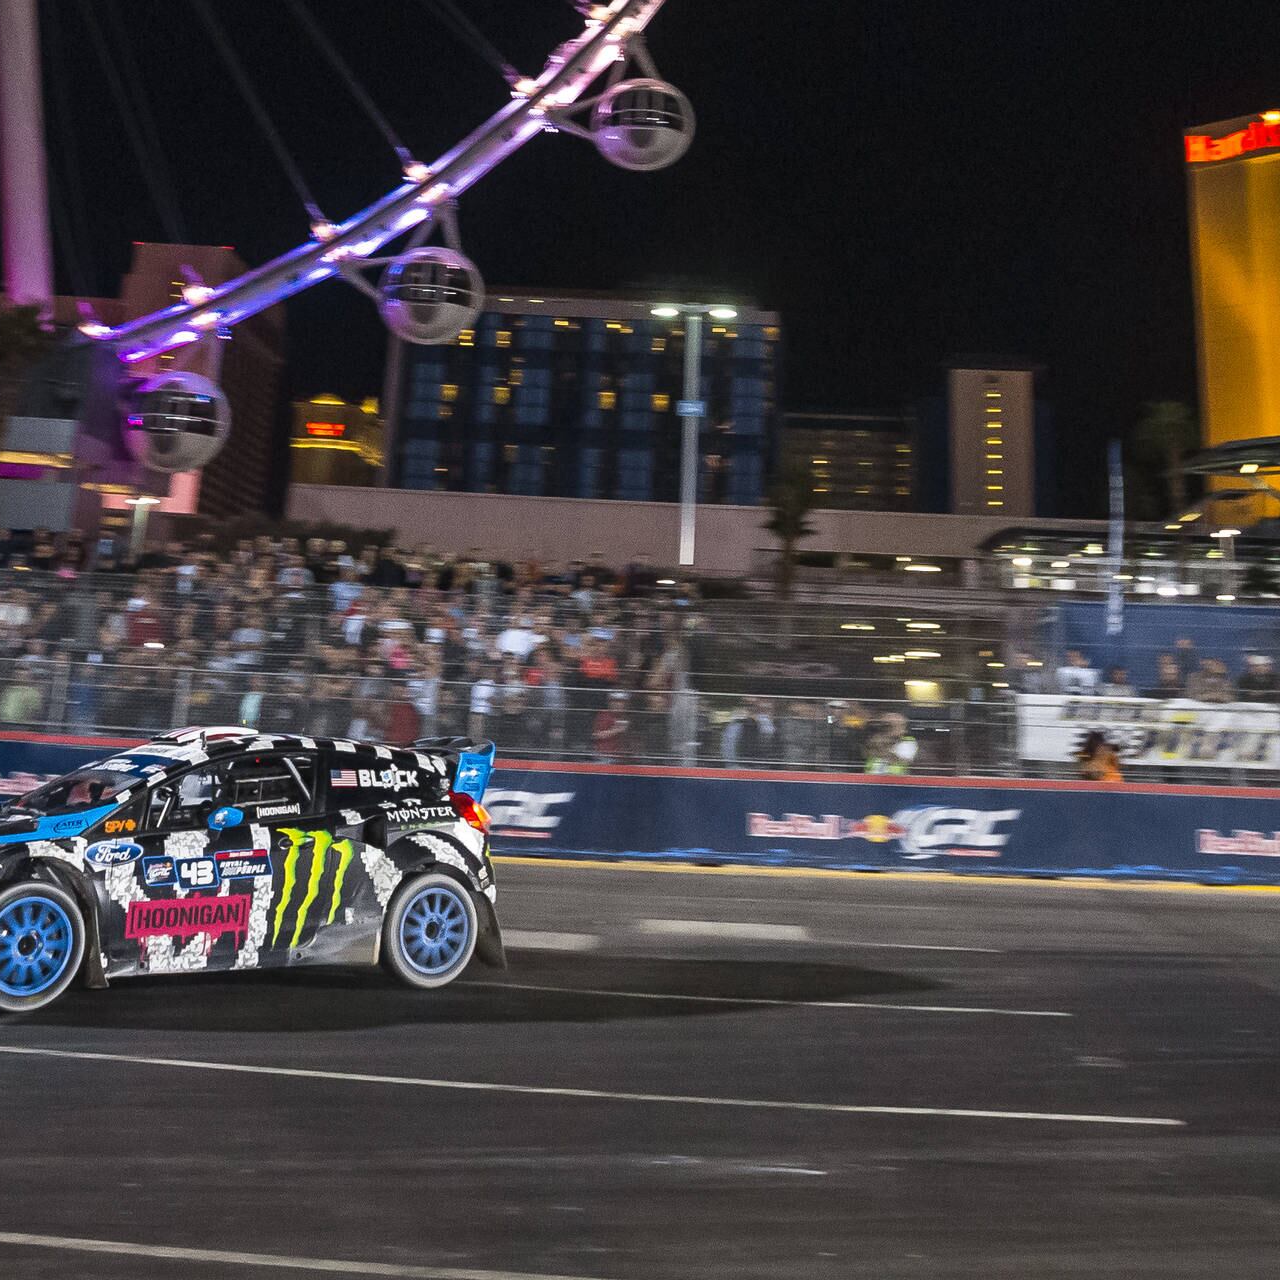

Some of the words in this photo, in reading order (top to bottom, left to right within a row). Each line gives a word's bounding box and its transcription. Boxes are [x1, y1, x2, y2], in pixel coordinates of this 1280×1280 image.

[387, 805, 456, 823] MONSTER
[95, 844, 131, 863] Ford
[180, 860, 214, 886] 43
